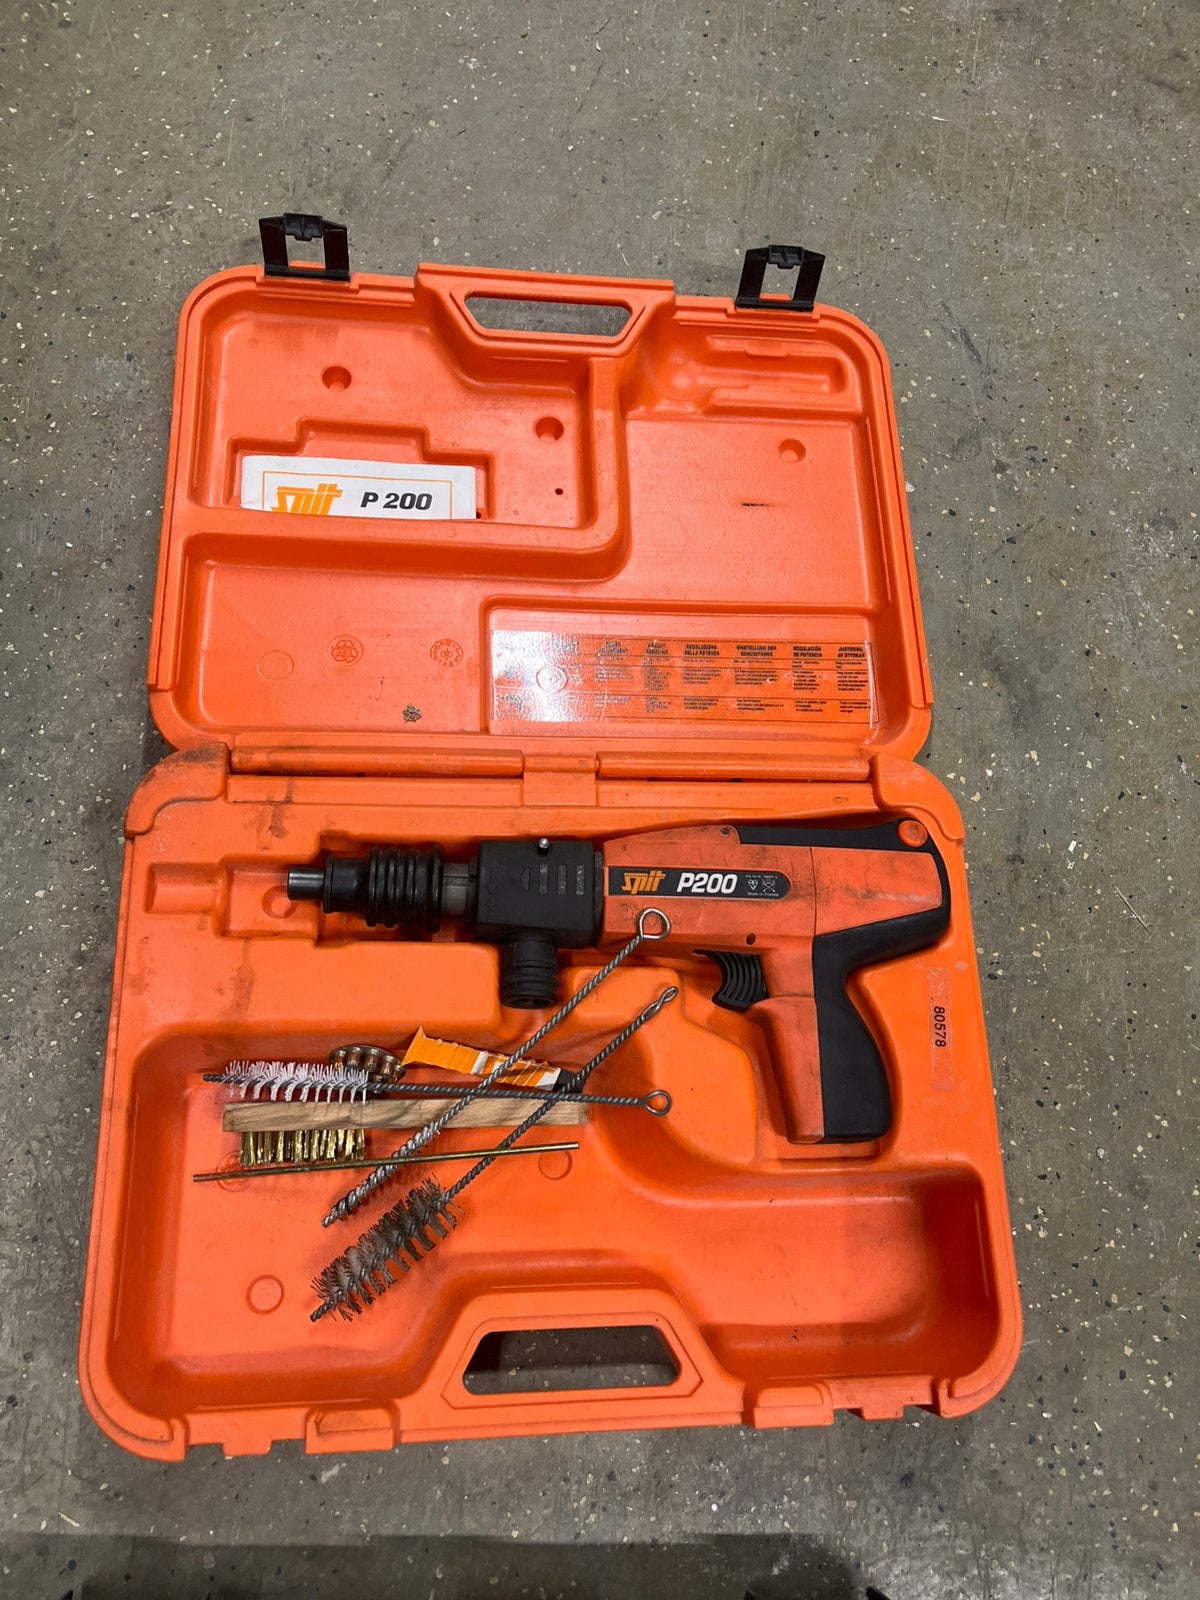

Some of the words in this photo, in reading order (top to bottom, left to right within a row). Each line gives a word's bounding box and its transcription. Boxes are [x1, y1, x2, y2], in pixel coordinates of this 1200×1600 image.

[360, 491, 378, 508] P
[383, 492, 433, 510] 200
[676, 872, 738, 894] P200
[934, 1006, 947, 1048] 80578
